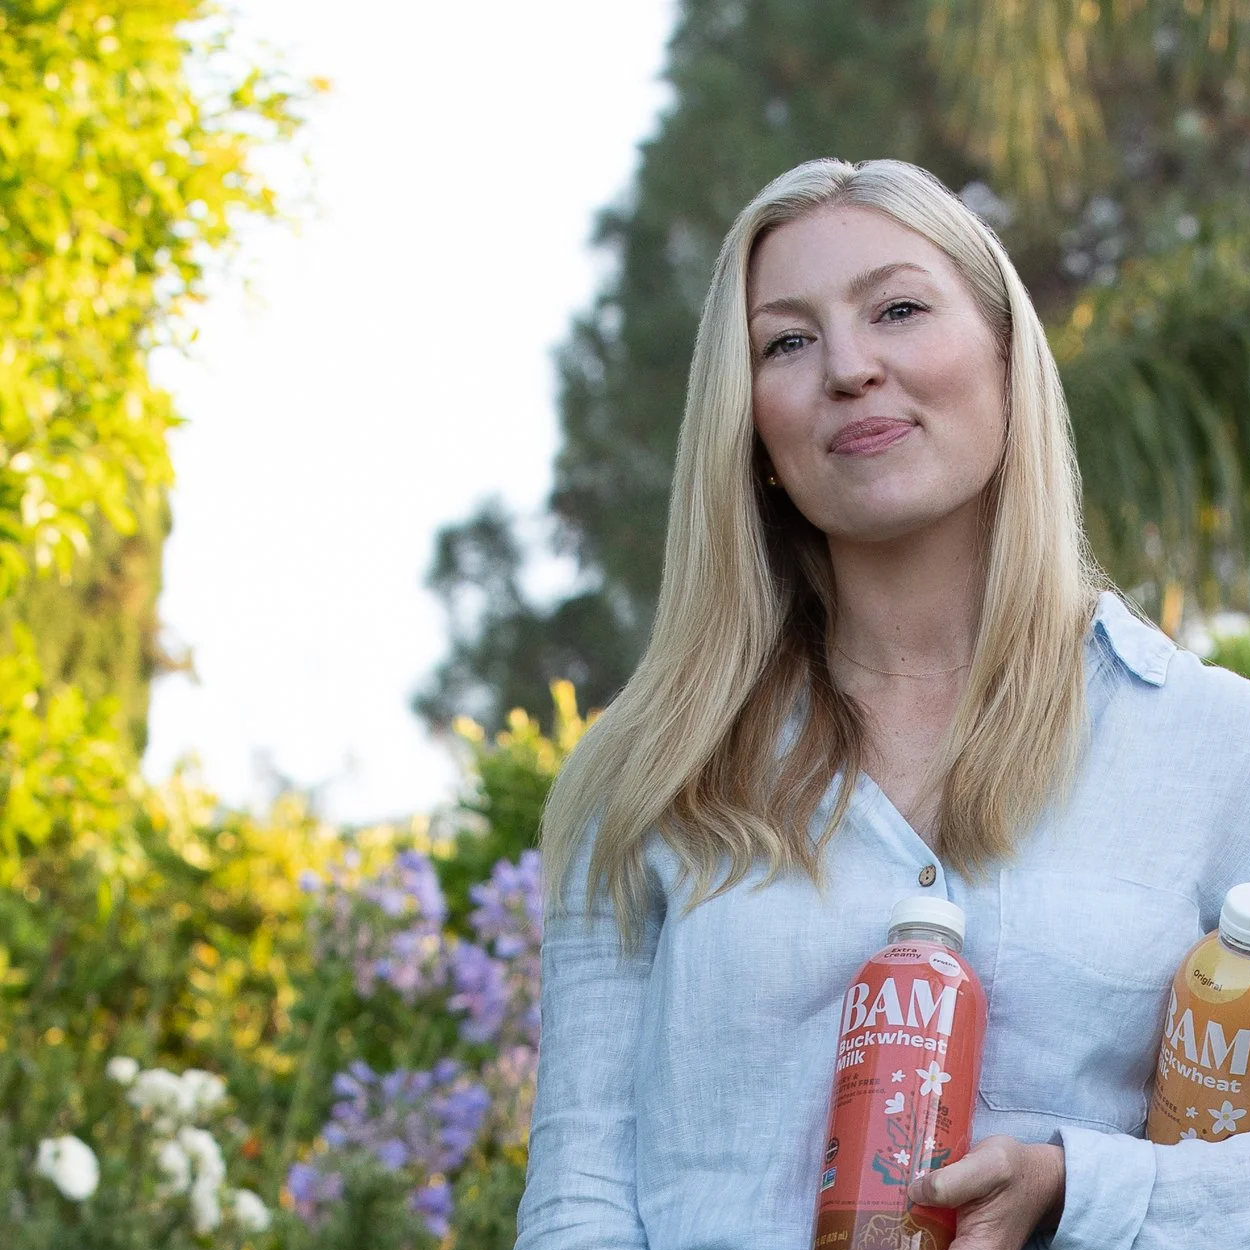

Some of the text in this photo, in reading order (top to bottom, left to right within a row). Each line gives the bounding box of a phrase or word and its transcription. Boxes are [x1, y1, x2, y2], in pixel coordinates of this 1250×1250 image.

[1193, 968, 1223, 992] Original
[841, 977, 959, 1037] BAM
[839, 1029, 948, 1056] Buckwheat
[836, 1049, 866, 1073] Milk
[1161, 1034, 1241, 1093] uckwheat
